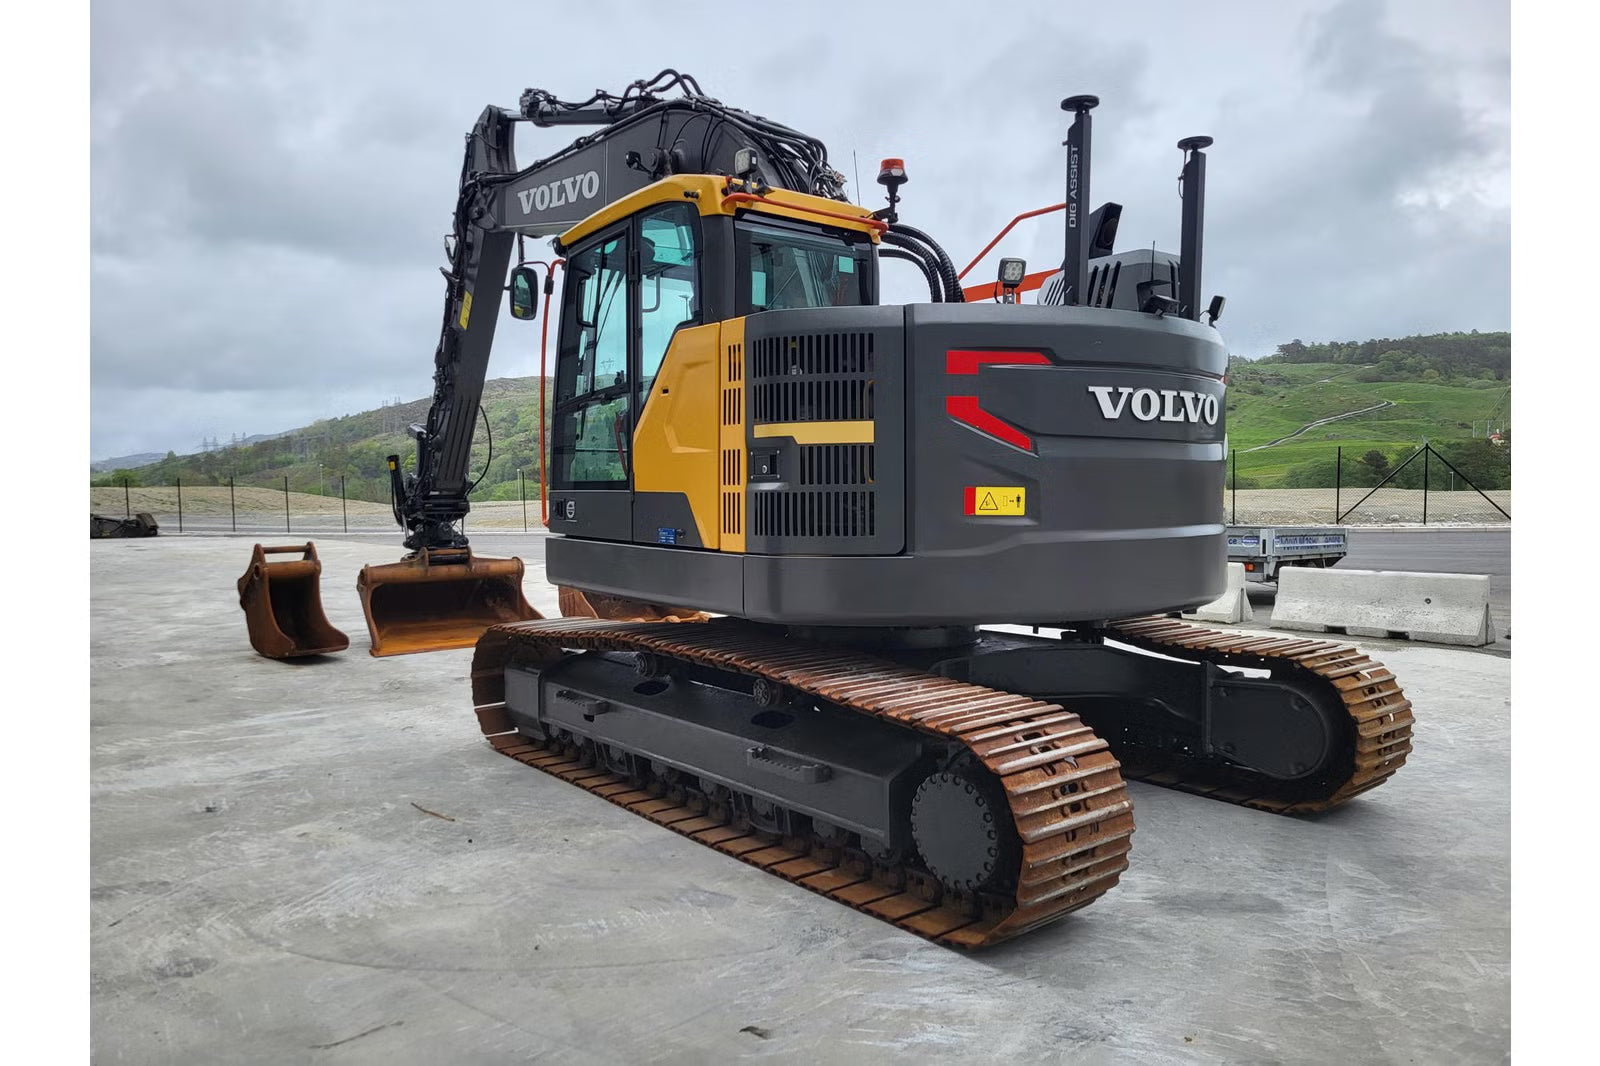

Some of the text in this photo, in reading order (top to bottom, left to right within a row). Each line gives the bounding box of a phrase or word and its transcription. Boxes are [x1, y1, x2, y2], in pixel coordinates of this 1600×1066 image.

[517, 171, 600, 215] VOLVO
[1069, 144, 1078, 228] DIG ASSIST
[1088, 385, 1219, 425] VOLVO
